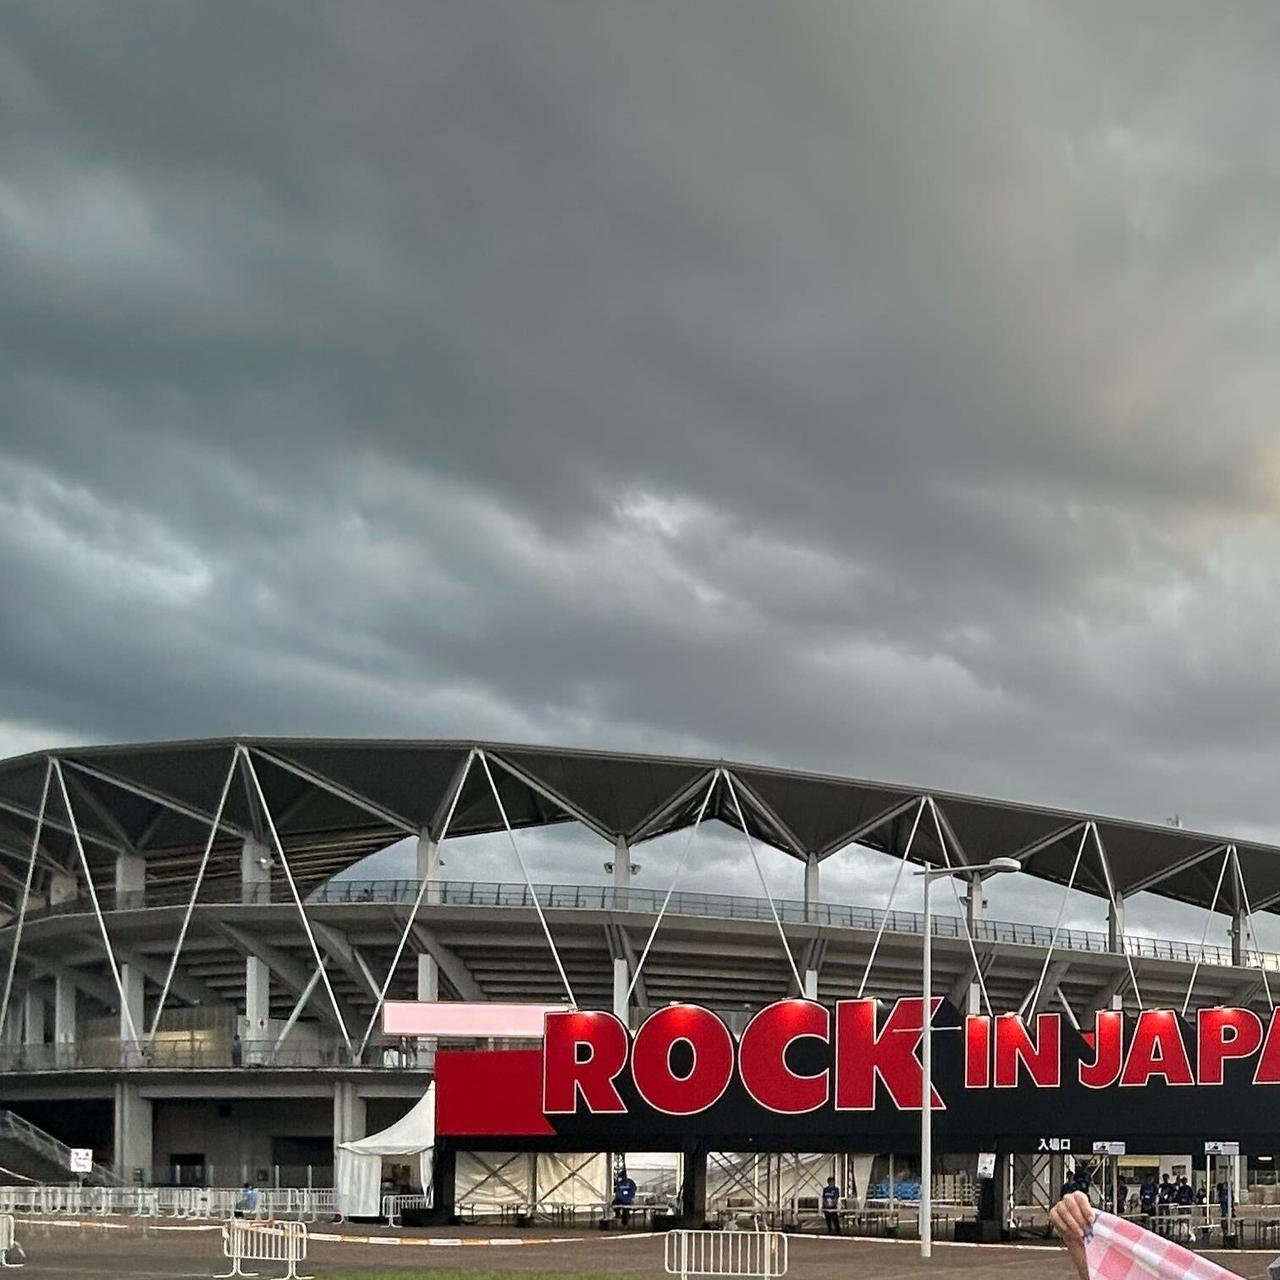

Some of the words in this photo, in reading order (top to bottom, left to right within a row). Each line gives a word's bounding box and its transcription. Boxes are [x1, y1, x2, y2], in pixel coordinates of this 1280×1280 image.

[543, 996, 946, 1115] ROCK
[965, 1013, 1061, 1089] IN
[1038, 1138, 1071, 1151] 入場口
